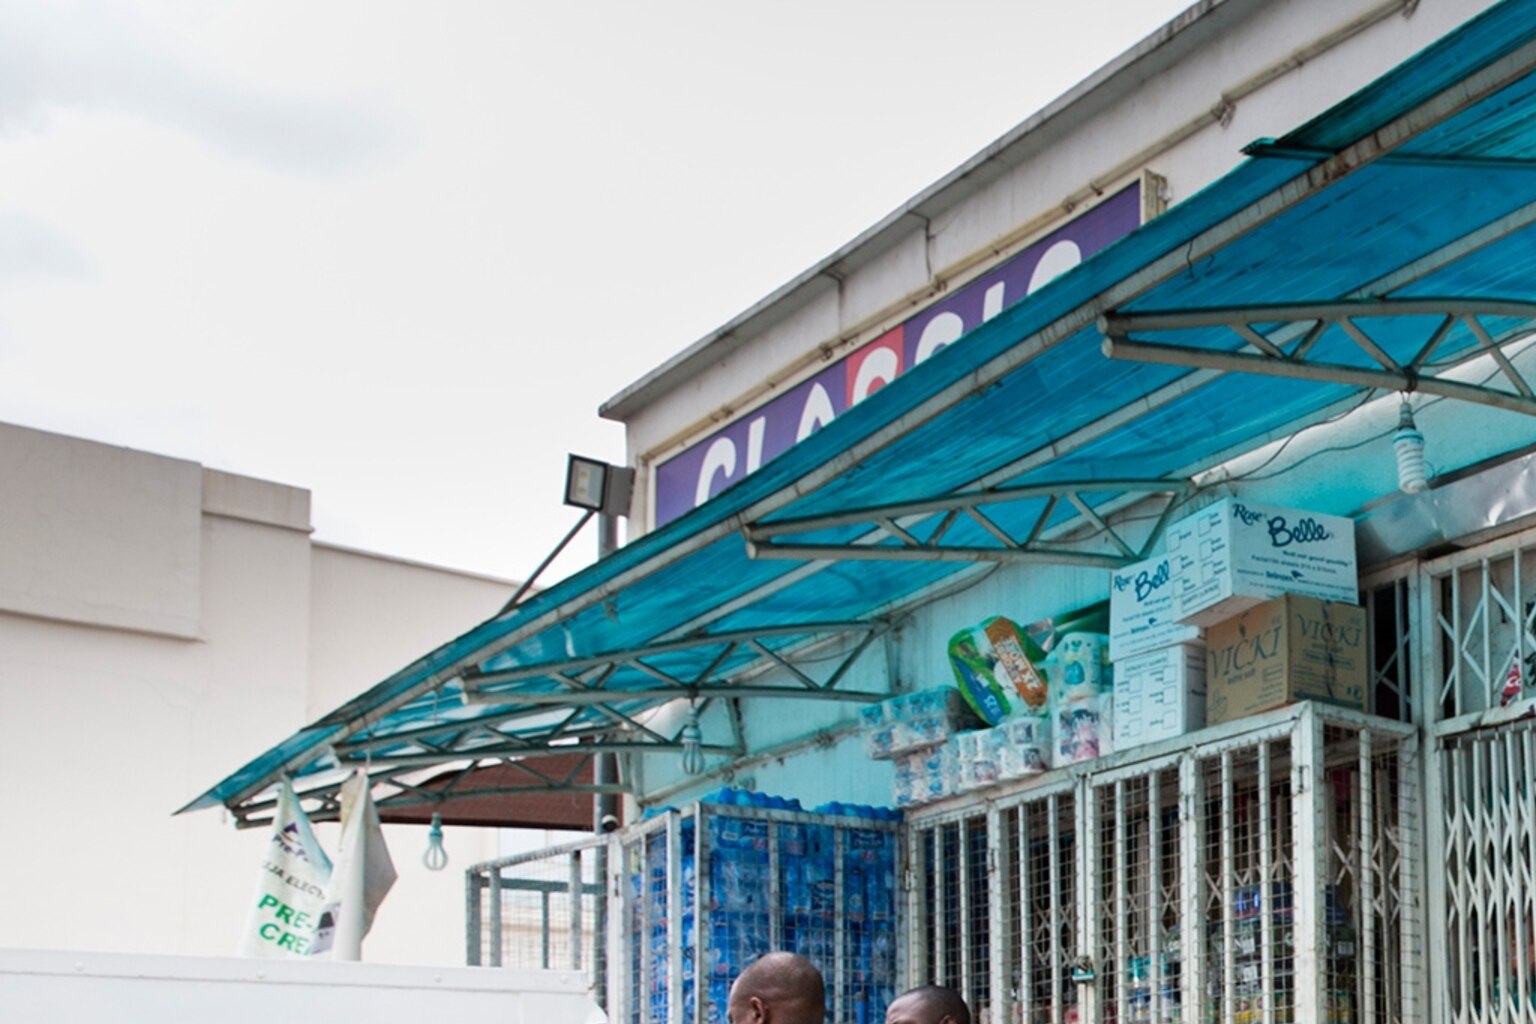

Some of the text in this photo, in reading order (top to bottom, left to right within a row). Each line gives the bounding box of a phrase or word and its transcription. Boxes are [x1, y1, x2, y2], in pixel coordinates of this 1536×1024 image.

[1233, 504, 1330, 547] Rose Belle
[1134, 559, 1170, 602] Bell
[1209, 624, 1282, 678] VICKI
